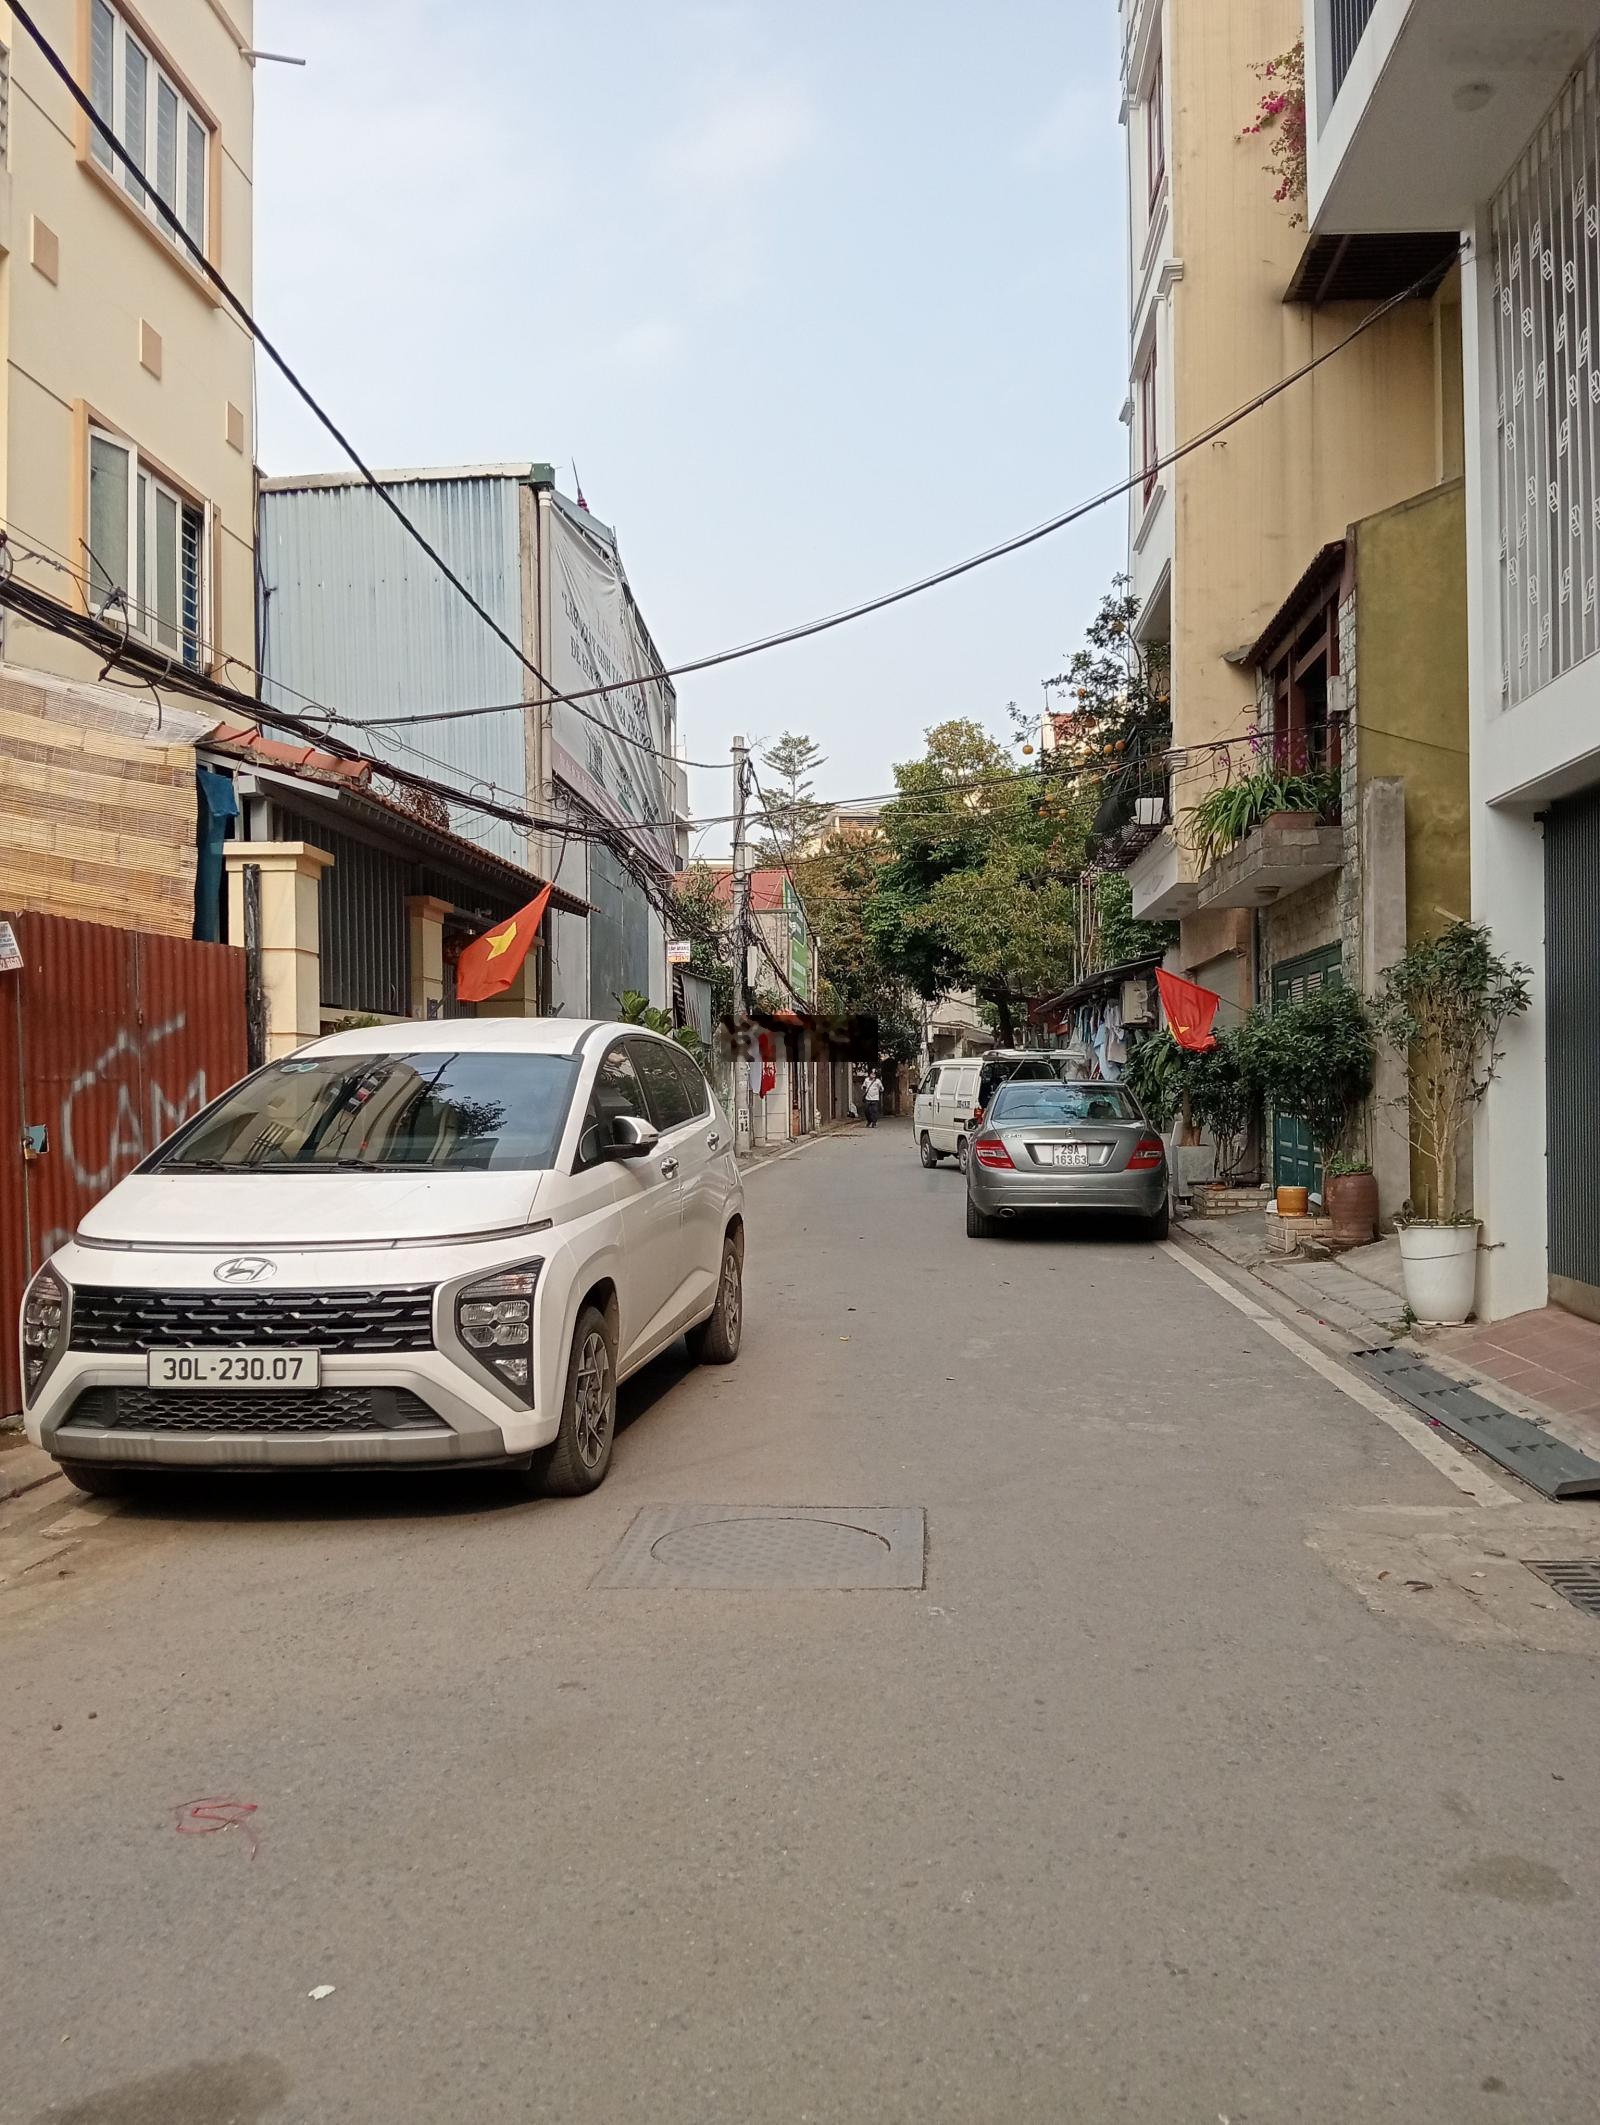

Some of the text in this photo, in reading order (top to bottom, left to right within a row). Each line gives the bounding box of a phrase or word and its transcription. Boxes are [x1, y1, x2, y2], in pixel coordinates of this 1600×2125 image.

[1061, 1144, 1079, 1155] 29A
[1056, 1155, 1087, 1165] 163.63
[163, 1357, 303, 1380] 30L-230.07
